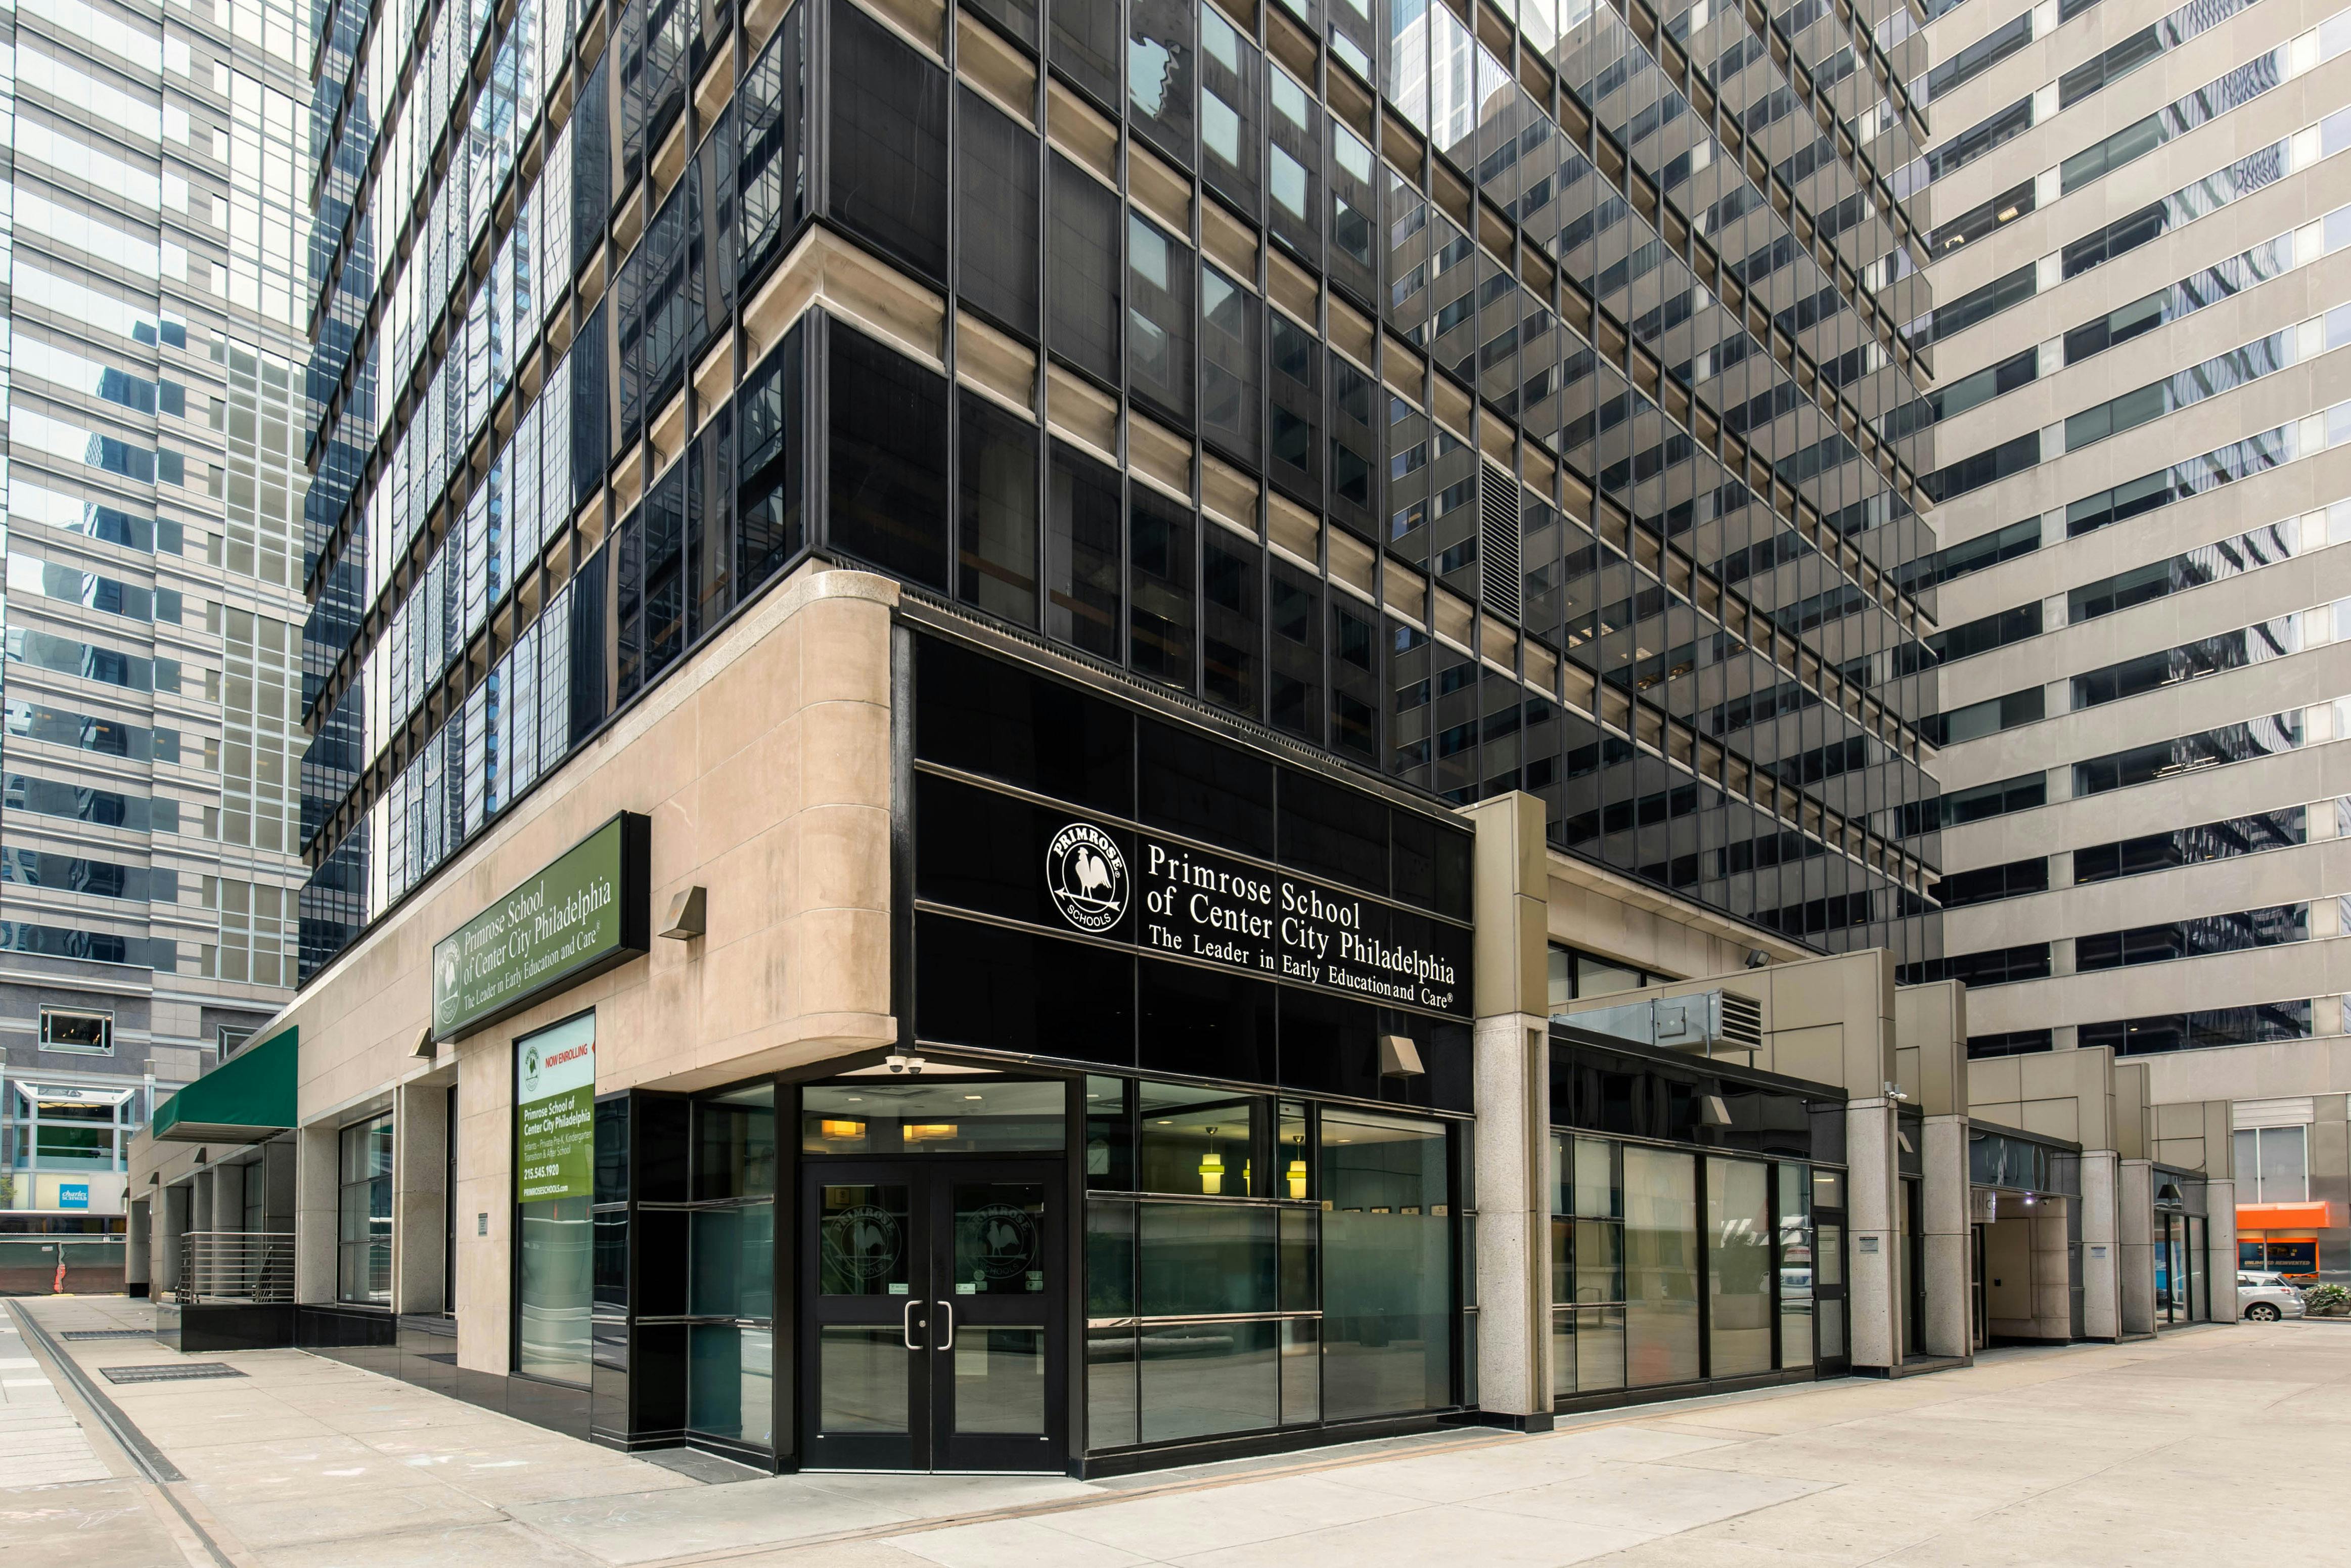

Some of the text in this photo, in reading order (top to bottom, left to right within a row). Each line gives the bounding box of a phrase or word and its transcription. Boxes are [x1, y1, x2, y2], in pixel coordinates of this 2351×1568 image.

[1148, 844, 1360, 929] Primrose School
[464, 876, 611, 985] of Center City Philadelphia
[465, 880, 544, 956] Primrose School
[1067, 904, 1111, 926] SCHOOLS
[1147, 886, 1455, 984] of Center City Philadelphia
[464, 995, 475, 1011] The
[476, 983, 496, 1005] Leader
[497, 977, 504, 994] in
[505, 967, 522, 988] Early
[524, 949, 559, 979] Education
[561, 935, 575, 960] and
[1149, 924, 1182, 949] The
[1193, 934, 1249, 965] Leader
[1259, 949, 1275, 970] in
[1282, 954, 1320, 983] Early
[1328, 965, 1391, 996] Education
[1393, 984, 1415, 1001] and
[546, 1054, 558, 1068] NOW
[559, 1043, 587, 1064] ENROLLING
[524, 1095, 575, 1121] Primrose School of
[524, 1108, 591, 1136] Center City Philadelphia
[524, 1163, 559, 1180] 215.545.1920
[557, 1143, 571, 1156] School
